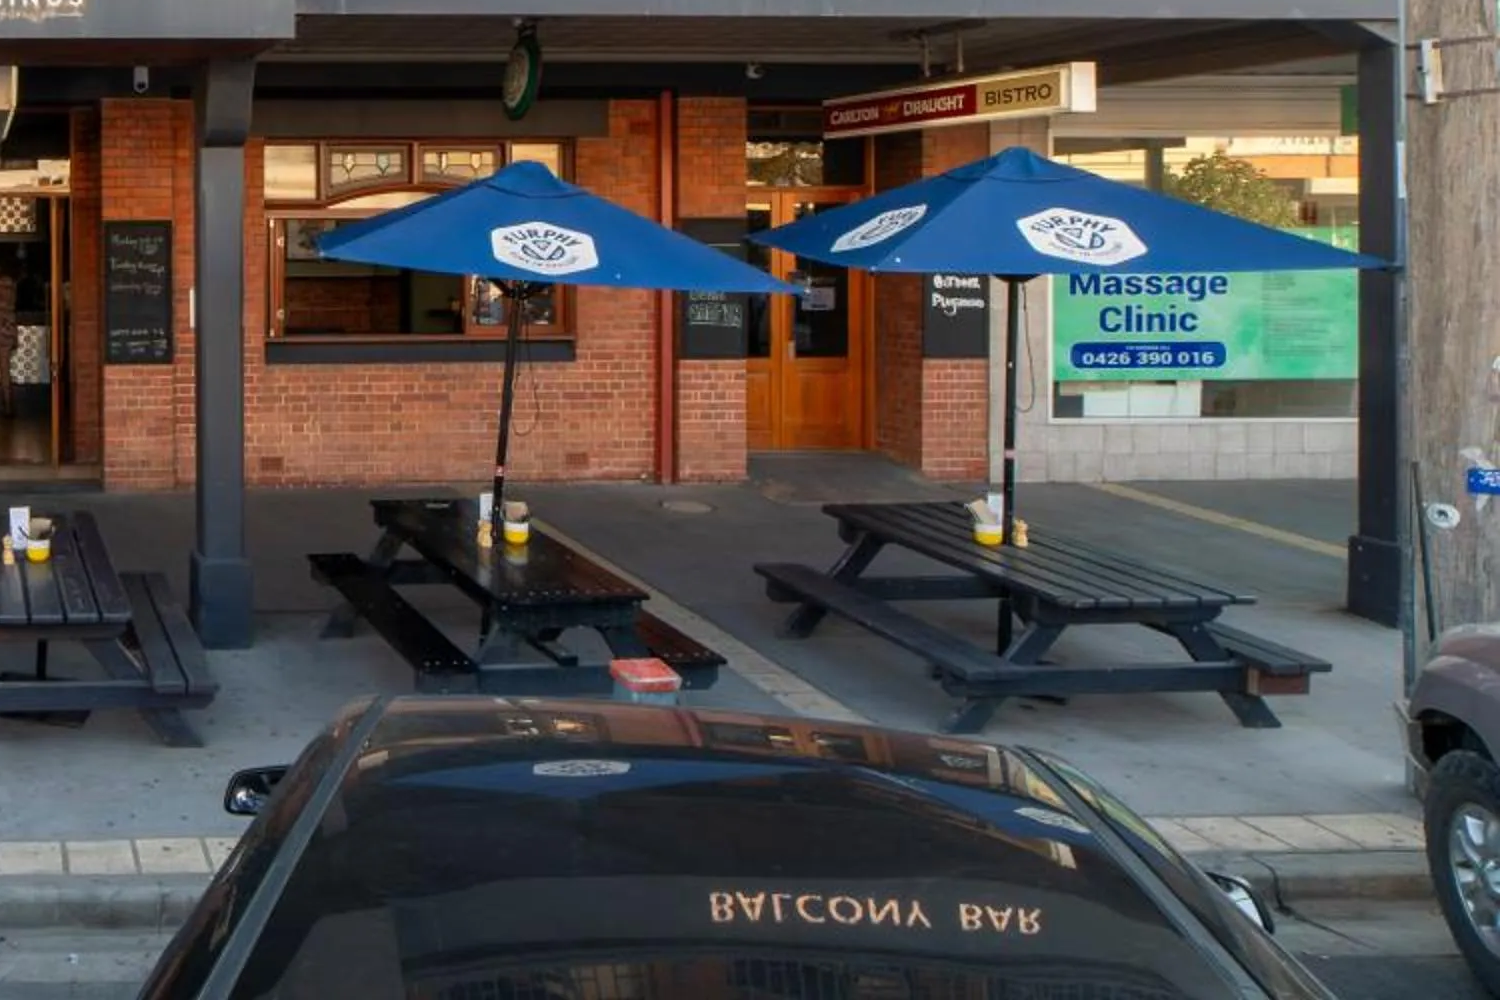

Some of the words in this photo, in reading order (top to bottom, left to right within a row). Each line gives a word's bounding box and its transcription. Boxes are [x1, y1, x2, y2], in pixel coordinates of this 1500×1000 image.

[830, 105, 880, 126] CARLTON
[903, 93, 966, 117] DRAUGHT
[984, 83, 1053, 107] BISTRO
[1031, 216, 1117, 235] FURPHY
[502, 229, 583, 247] FURPHY
[1069, 273, 1229, 301] Massage
[1099, 305, 1198, 333] Clinic
[1081, 351, 1131, 366] 0426
[1136, 351, 1173, 366] 390
[1177, 351, 1215, 366] 016
